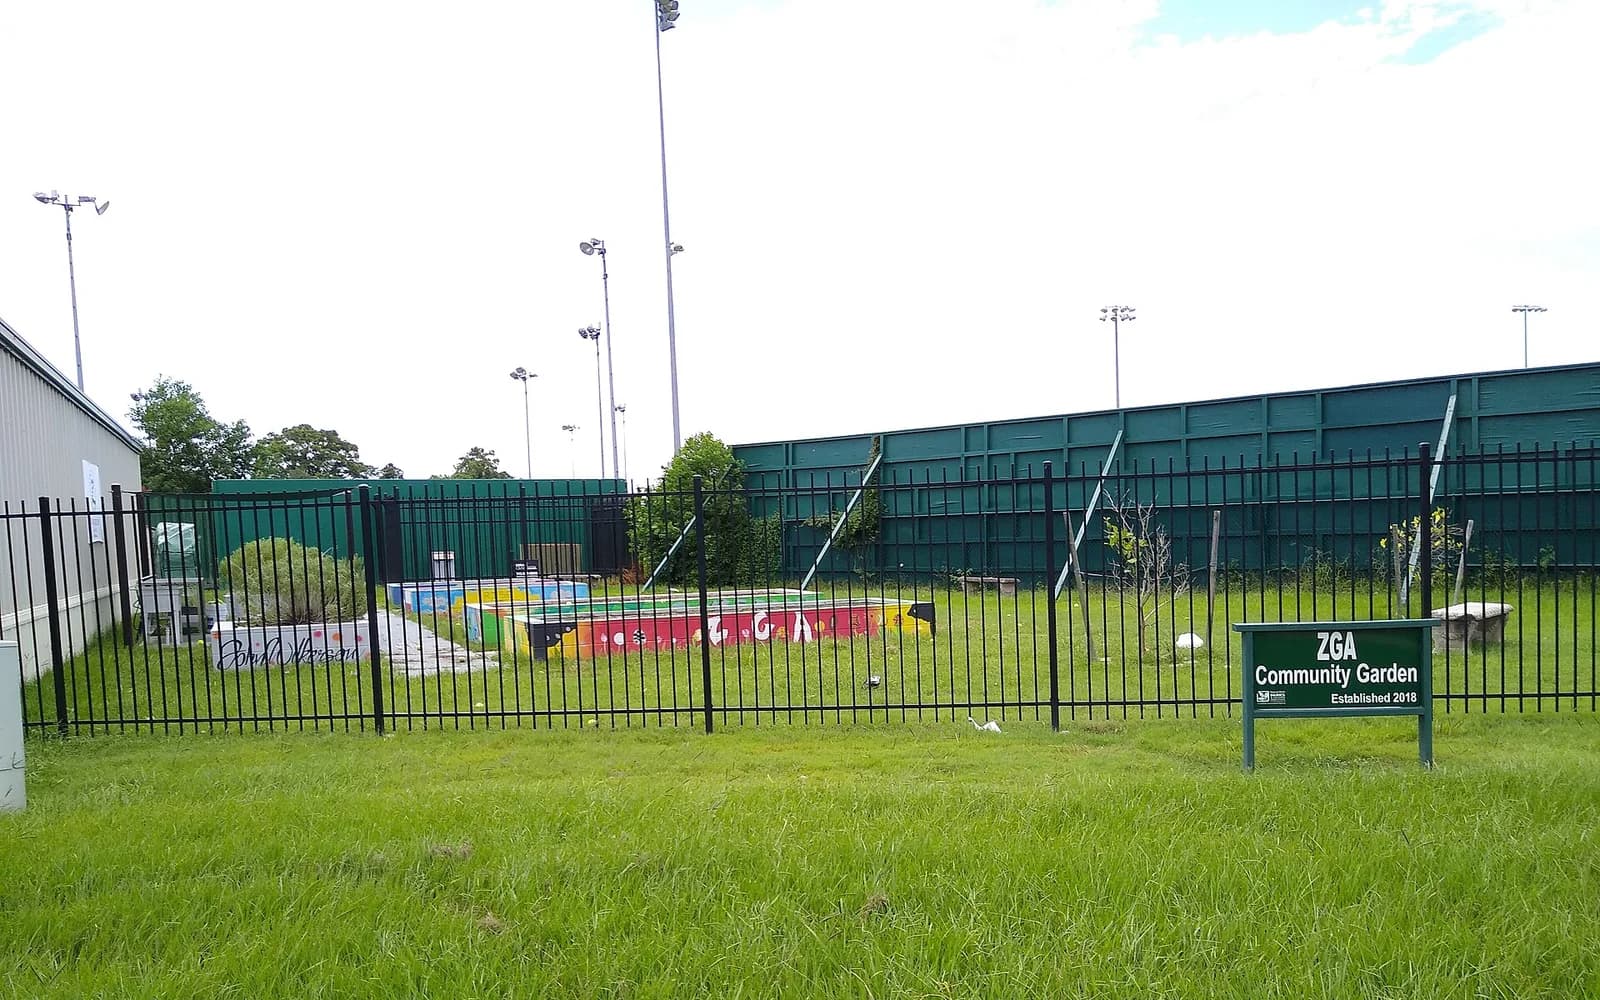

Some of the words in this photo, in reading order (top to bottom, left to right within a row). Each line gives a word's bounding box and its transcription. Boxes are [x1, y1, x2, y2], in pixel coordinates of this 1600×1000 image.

[1317, 632, 1357, 661] ZGA
[1255, 664, 1351, 688] Community
[1356, 662, 1418, 684] Garden
[1331, 692, 1391, 704] Established
[1392, 692, 1417, 703] 2018
